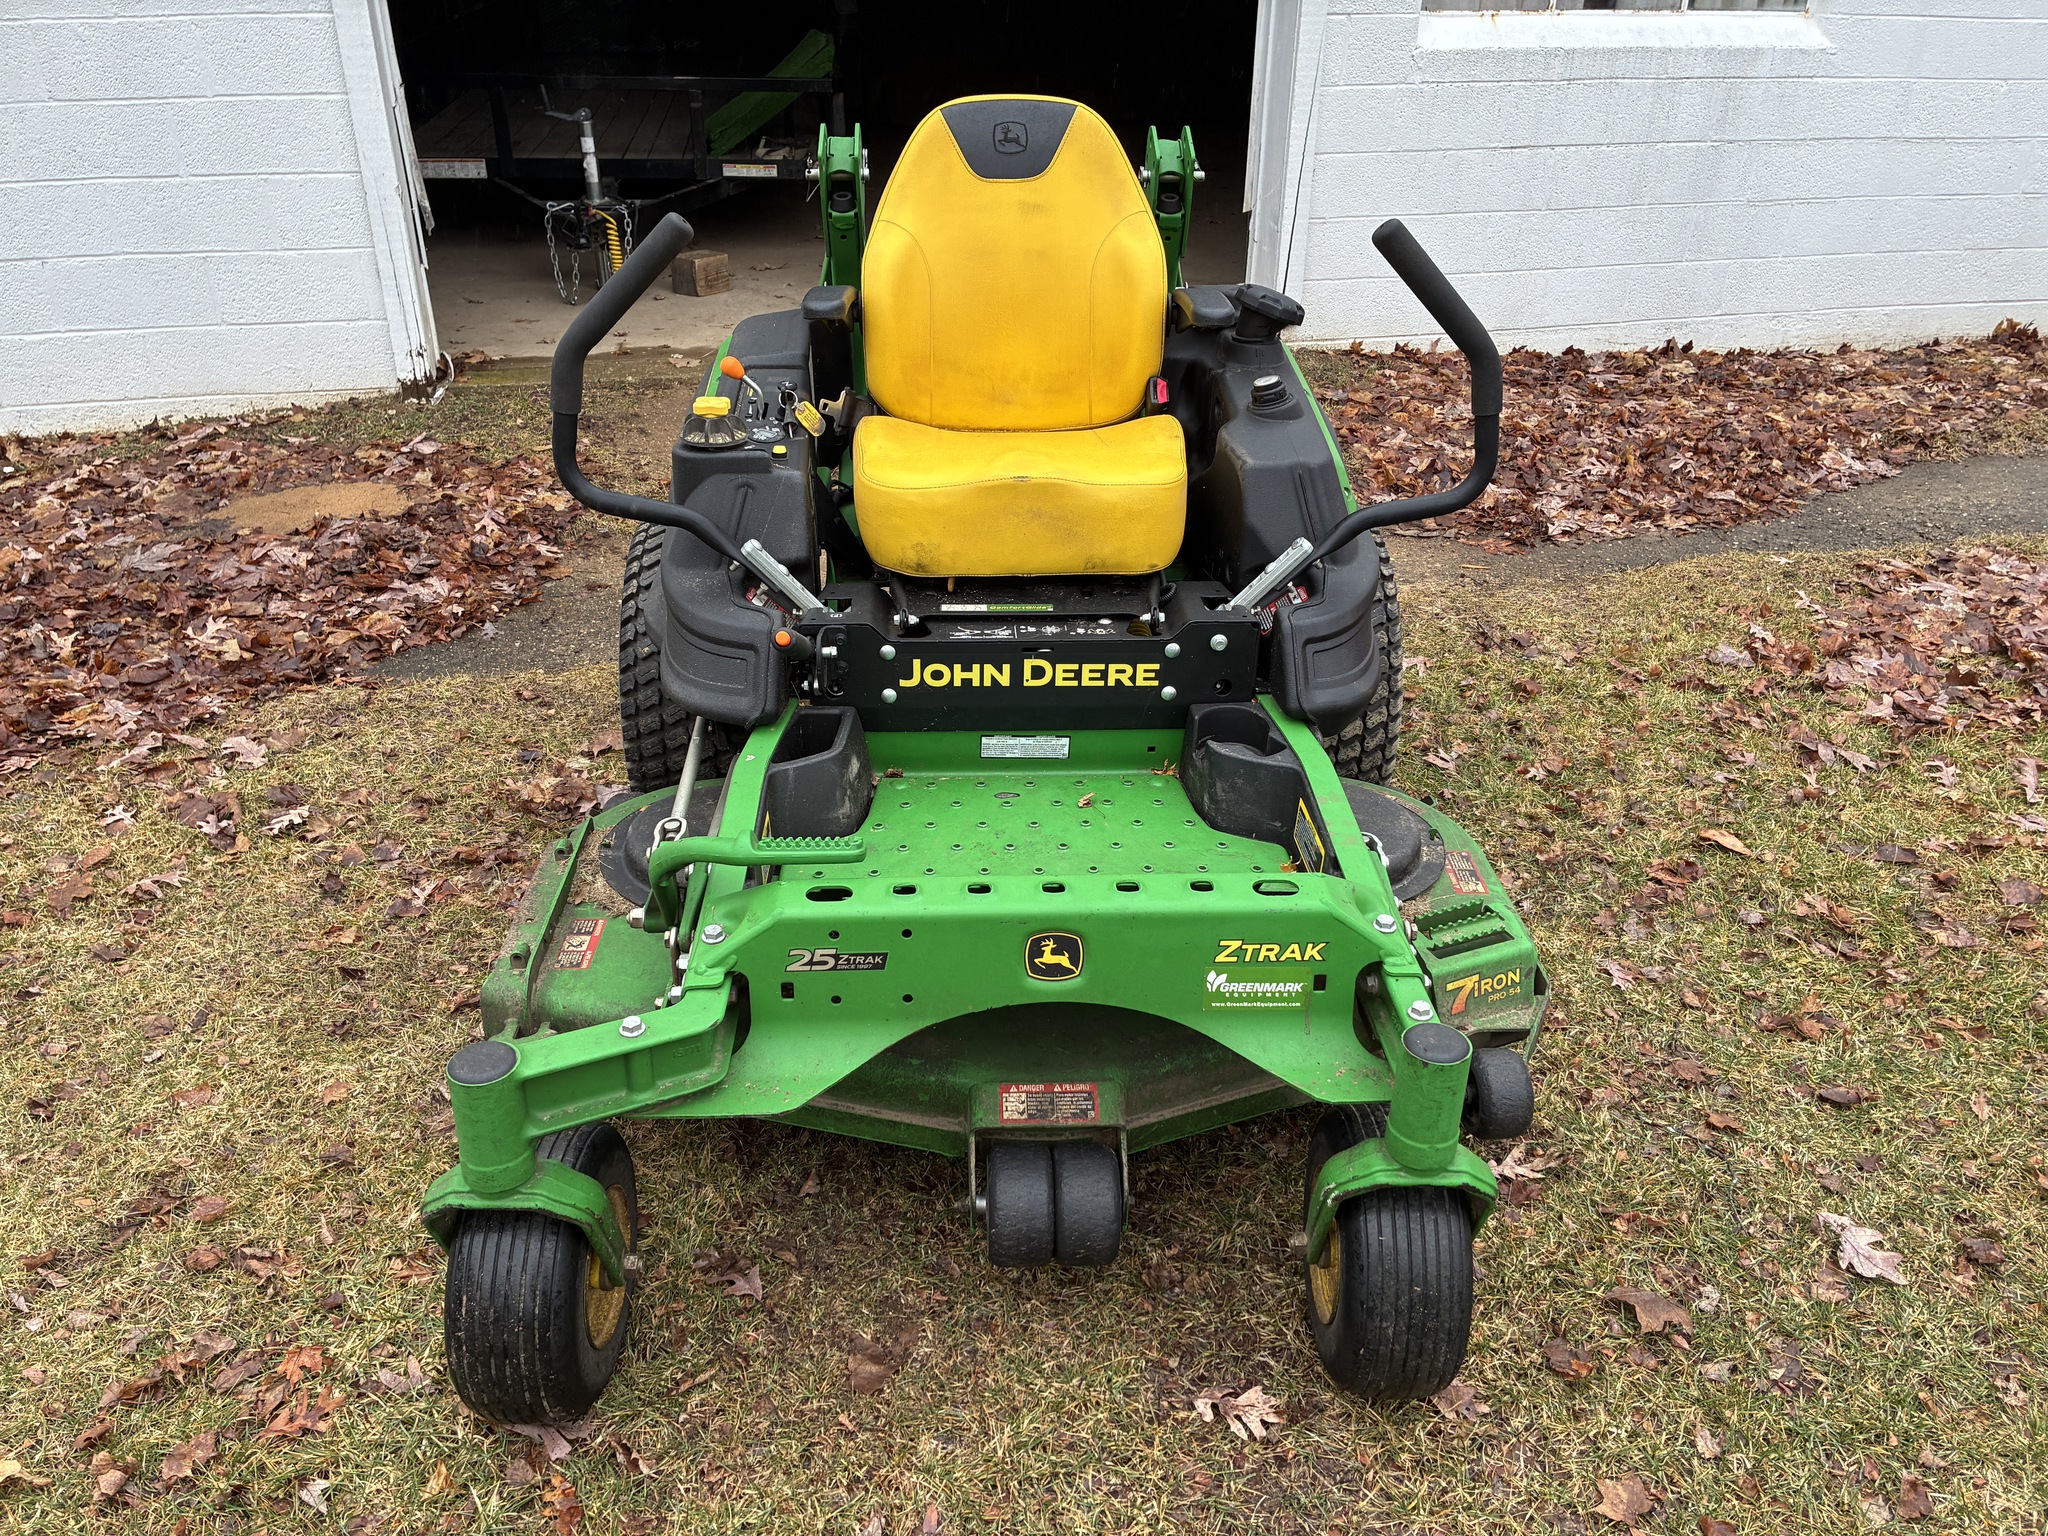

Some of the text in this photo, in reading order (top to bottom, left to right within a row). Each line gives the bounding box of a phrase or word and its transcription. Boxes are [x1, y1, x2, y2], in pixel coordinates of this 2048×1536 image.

[899, 658, 1160, 687] JOHN DEERE
[1214, 939, 1328, 963] ZTRAK
[785, 948, 884, 972] 25 ZTRAK
[1220, 982, 1304, 993] GREENMARK
[1487, 986, 1522, 1003] PRO 54
[1018, 1084, 1045, 1092] DANGER
[1062, 1083, 1090, 1091] PELIGRO
